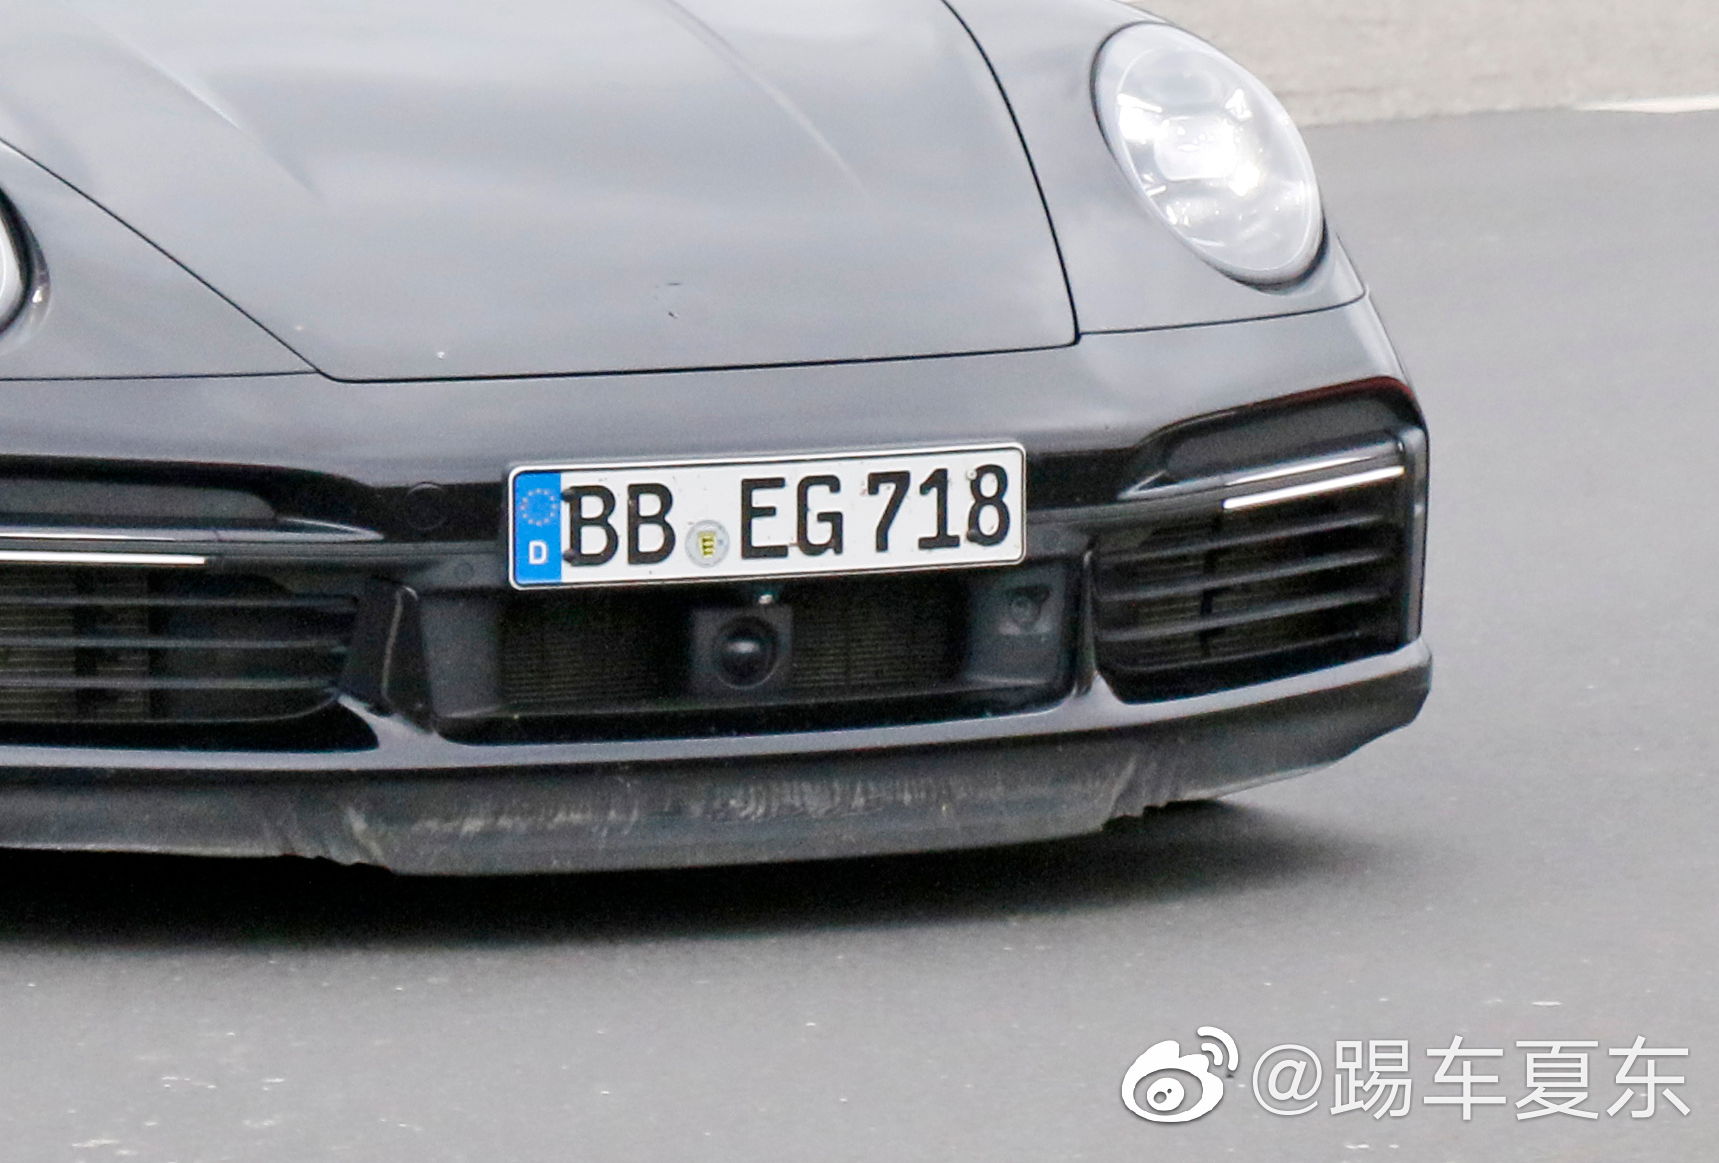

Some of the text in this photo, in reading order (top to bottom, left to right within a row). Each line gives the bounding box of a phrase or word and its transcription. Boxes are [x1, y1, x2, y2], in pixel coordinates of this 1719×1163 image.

[565, 464, 1011, 567] BB EG 718
[528, 540, 548, 565] D
